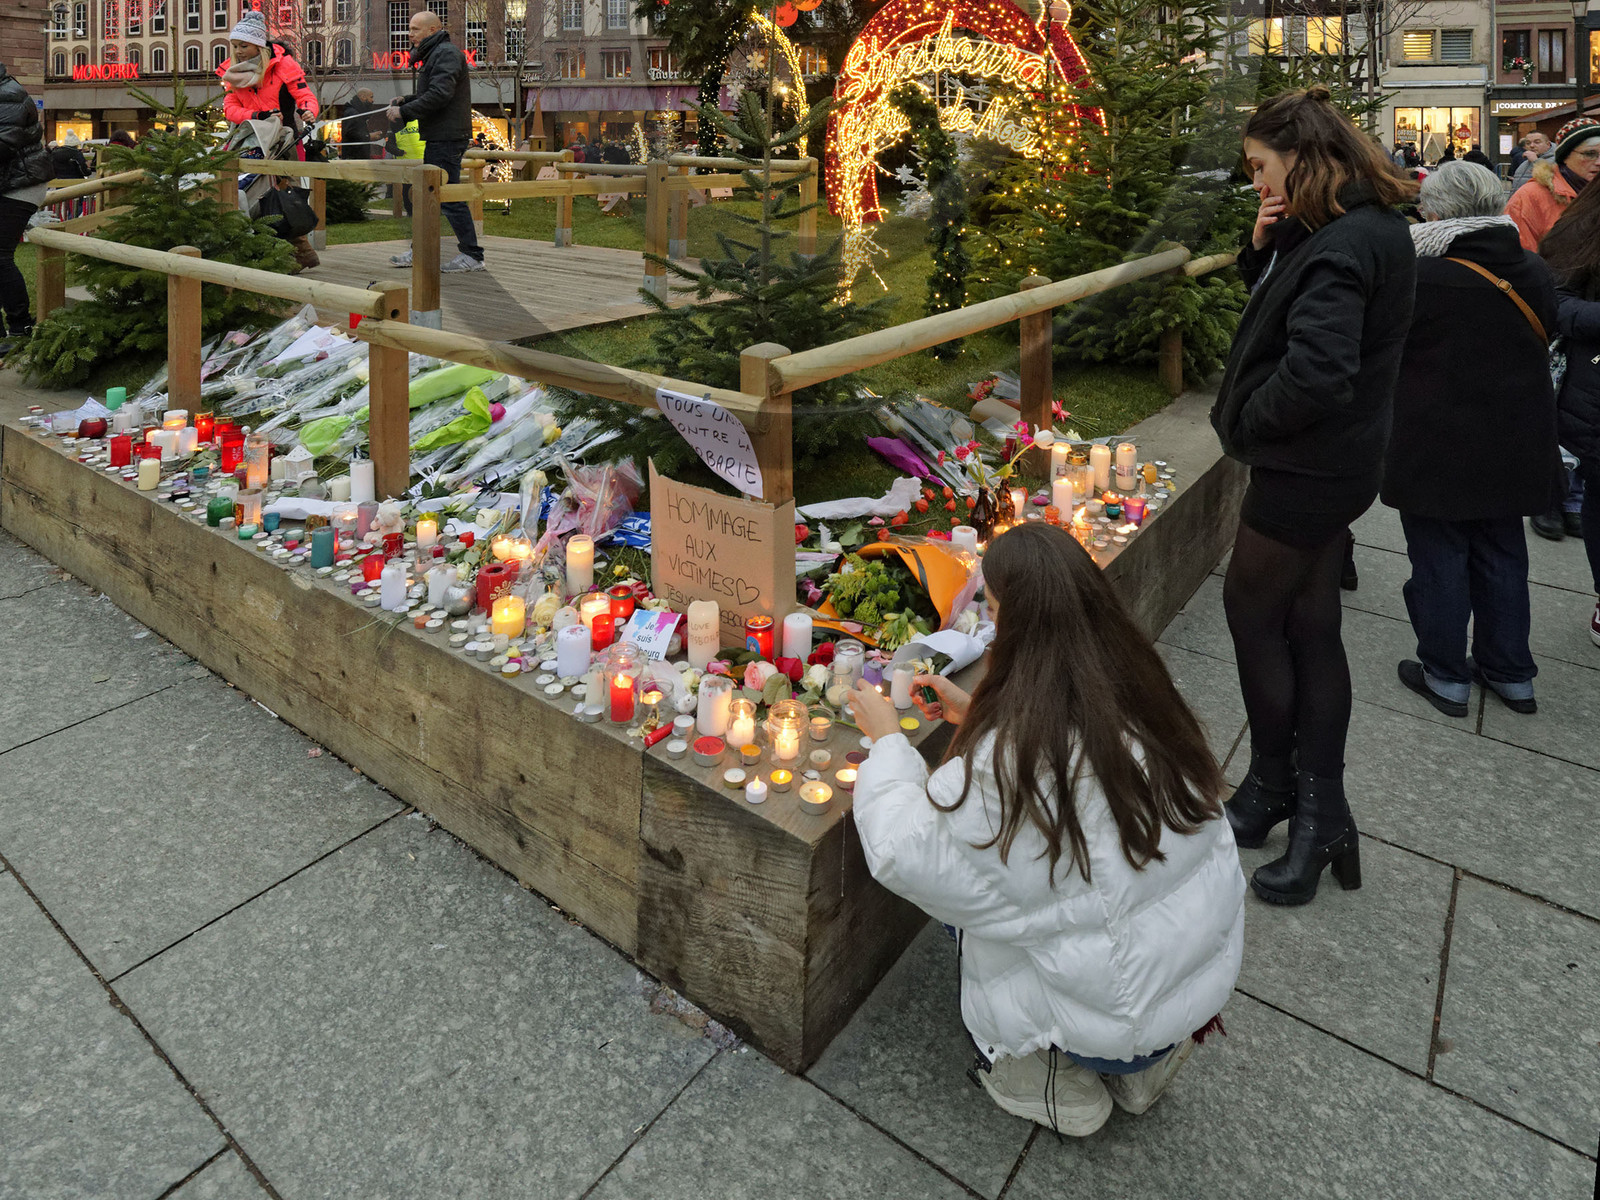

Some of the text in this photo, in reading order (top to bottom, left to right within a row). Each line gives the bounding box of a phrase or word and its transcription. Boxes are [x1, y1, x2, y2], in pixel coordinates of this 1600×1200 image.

[73, 63, 139, 80] MONOPRIX
[661, 394, 703, 418] TOUS
[669, 418, 751, 453] ONTRE LA
[666, 488, 762, 542] HOMMAGE
[685, 534, 717, 562] AUX
[668, 553, 735, 597] VICTIMES
[636, 634, 652, 643] suis
[645, 622, 655, 631] Je
